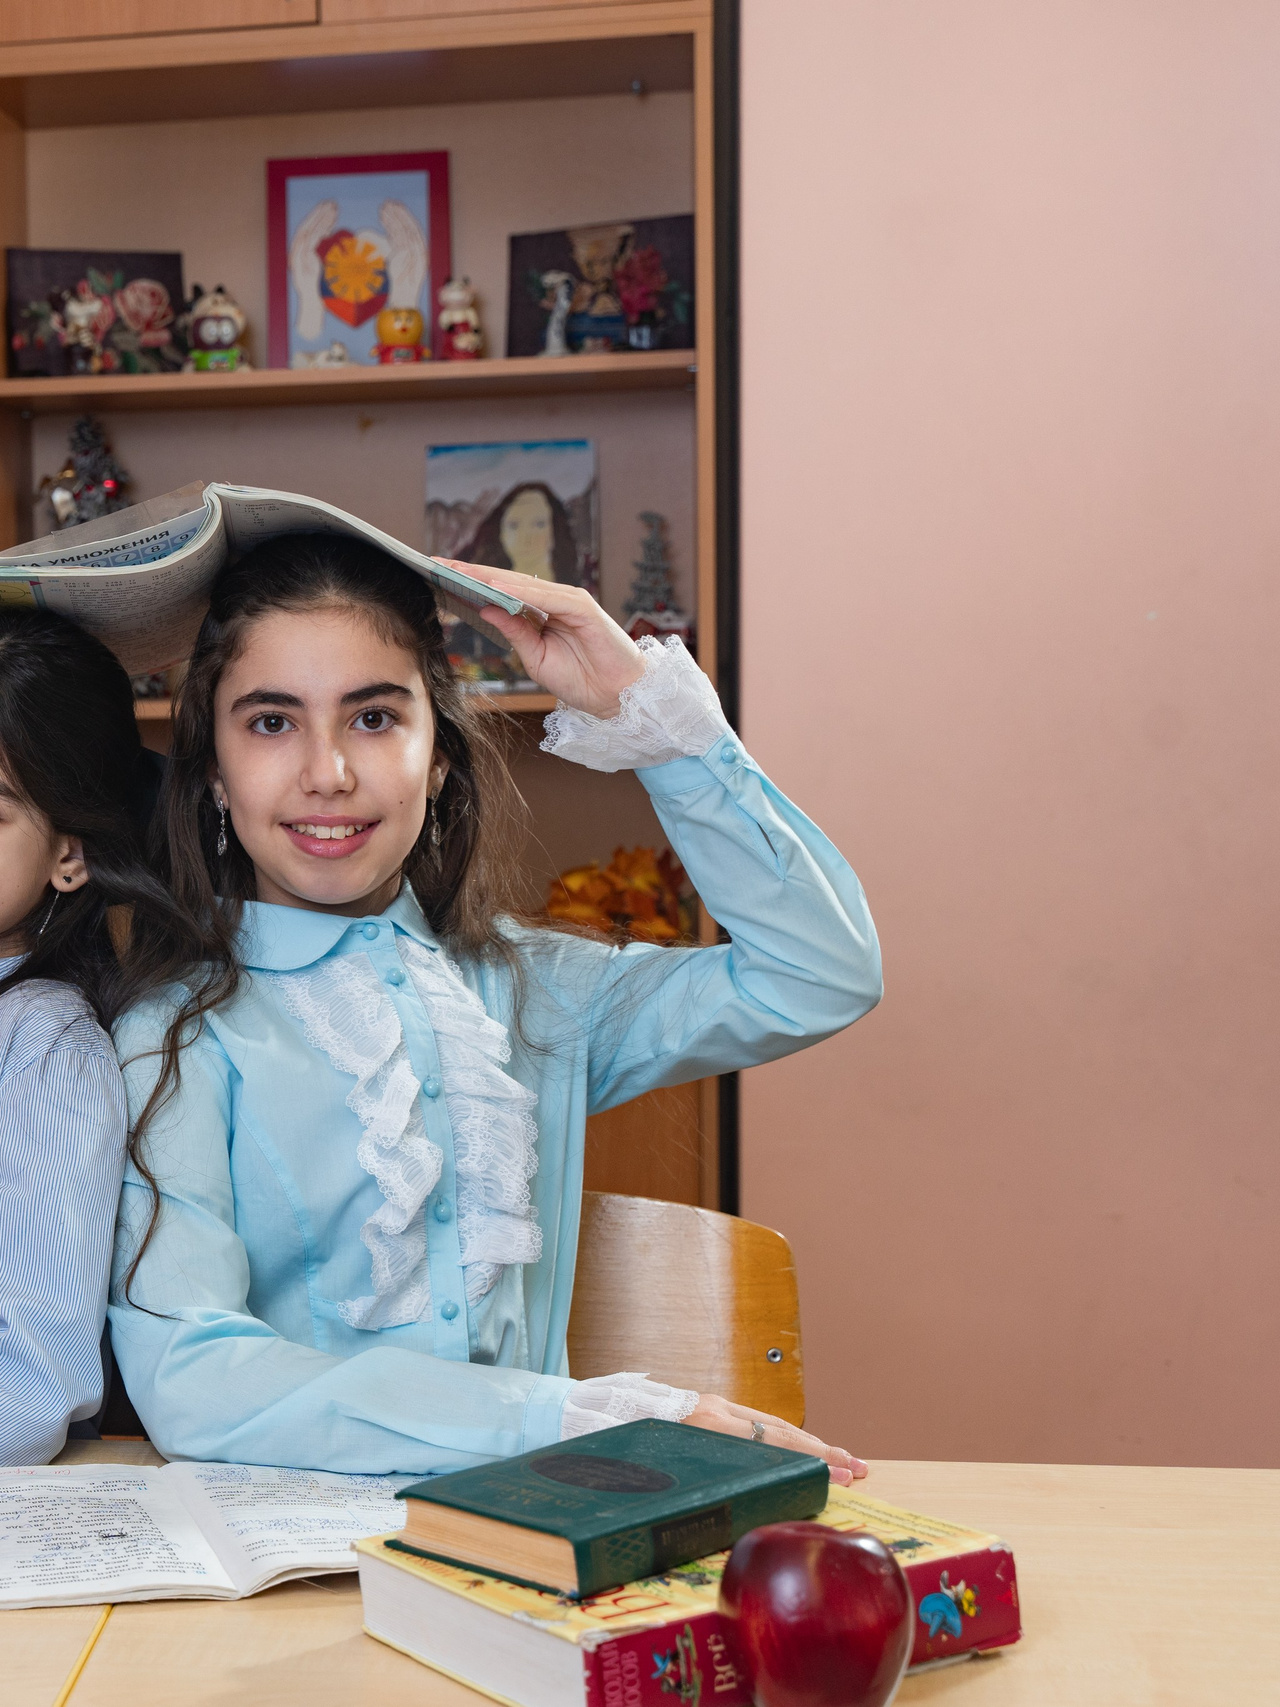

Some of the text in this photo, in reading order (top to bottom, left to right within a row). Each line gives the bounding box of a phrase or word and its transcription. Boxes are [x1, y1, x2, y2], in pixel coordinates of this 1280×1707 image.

[48, 530, 170, 565] УМНОЖЕНИЯ
[121, 553, 131, 561] 7
[150, 545, 161, 553] 8
[179, 533, 190, 542] 9
[621, 1650, 642, 1707] ОСОВ
